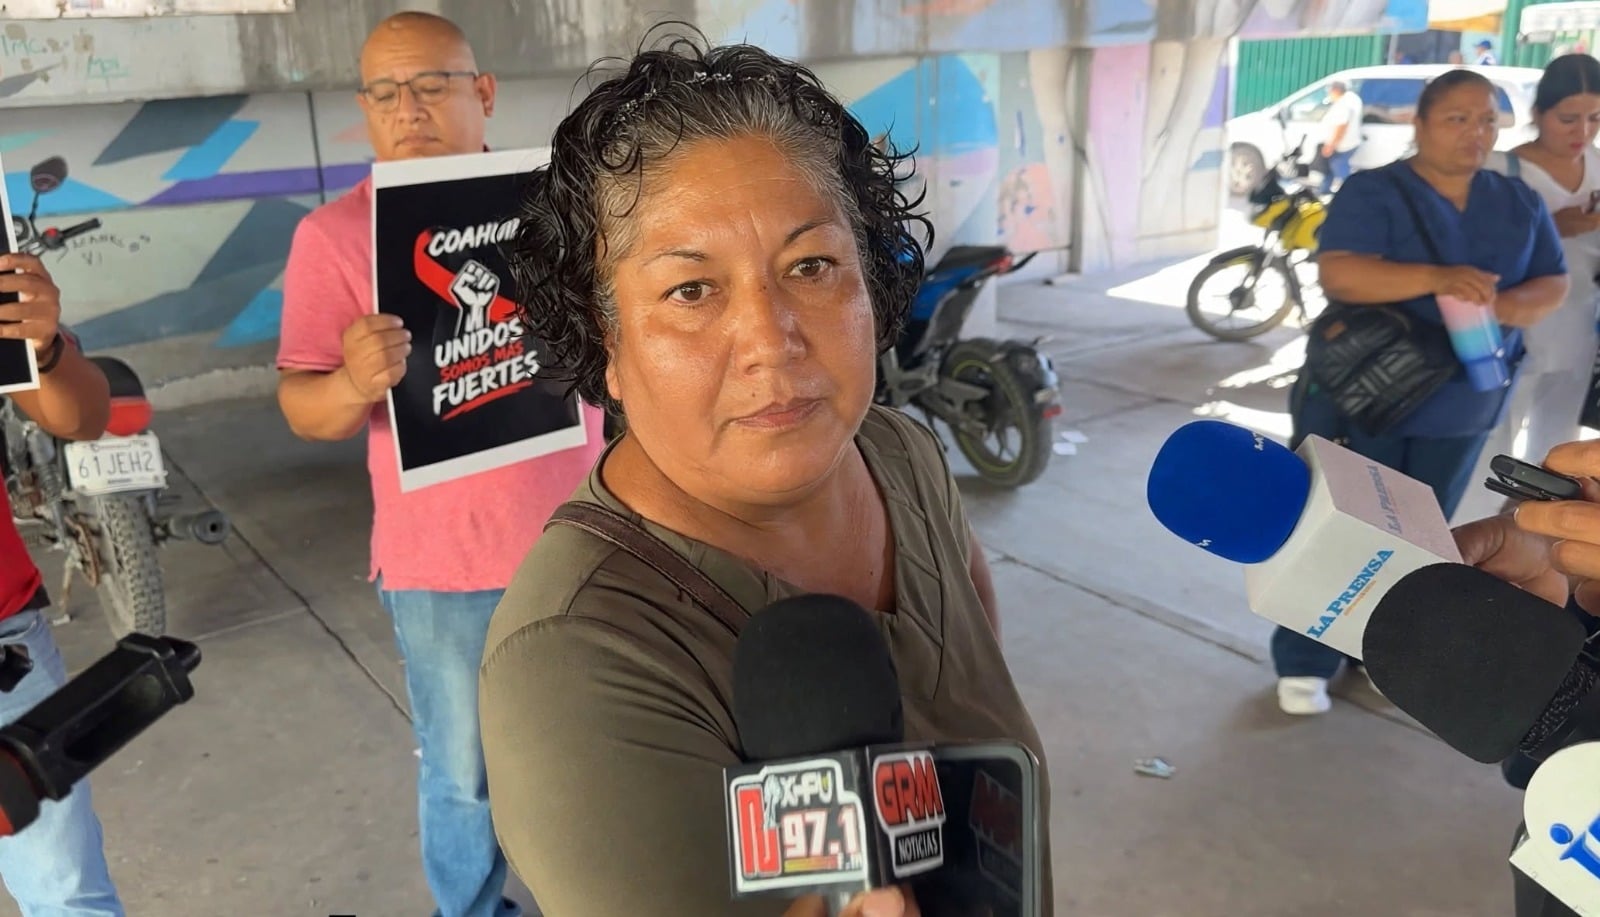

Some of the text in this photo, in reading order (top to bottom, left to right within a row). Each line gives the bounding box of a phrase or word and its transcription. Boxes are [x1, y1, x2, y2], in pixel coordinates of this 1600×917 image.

[434, 316, 524, 369] UNIDOS
[440, 353, 491, 384] SOMOS
[432, 350, 540, 416] FUERTES
[1306, 614, 1337, 639] LA
[1326, 550, 1394, 616] PRENSA
[875, 756, 943, 826] GRM
[782, 805, 859, 858] 97.1
[898, 831, 938, 863] NOTICIAS
